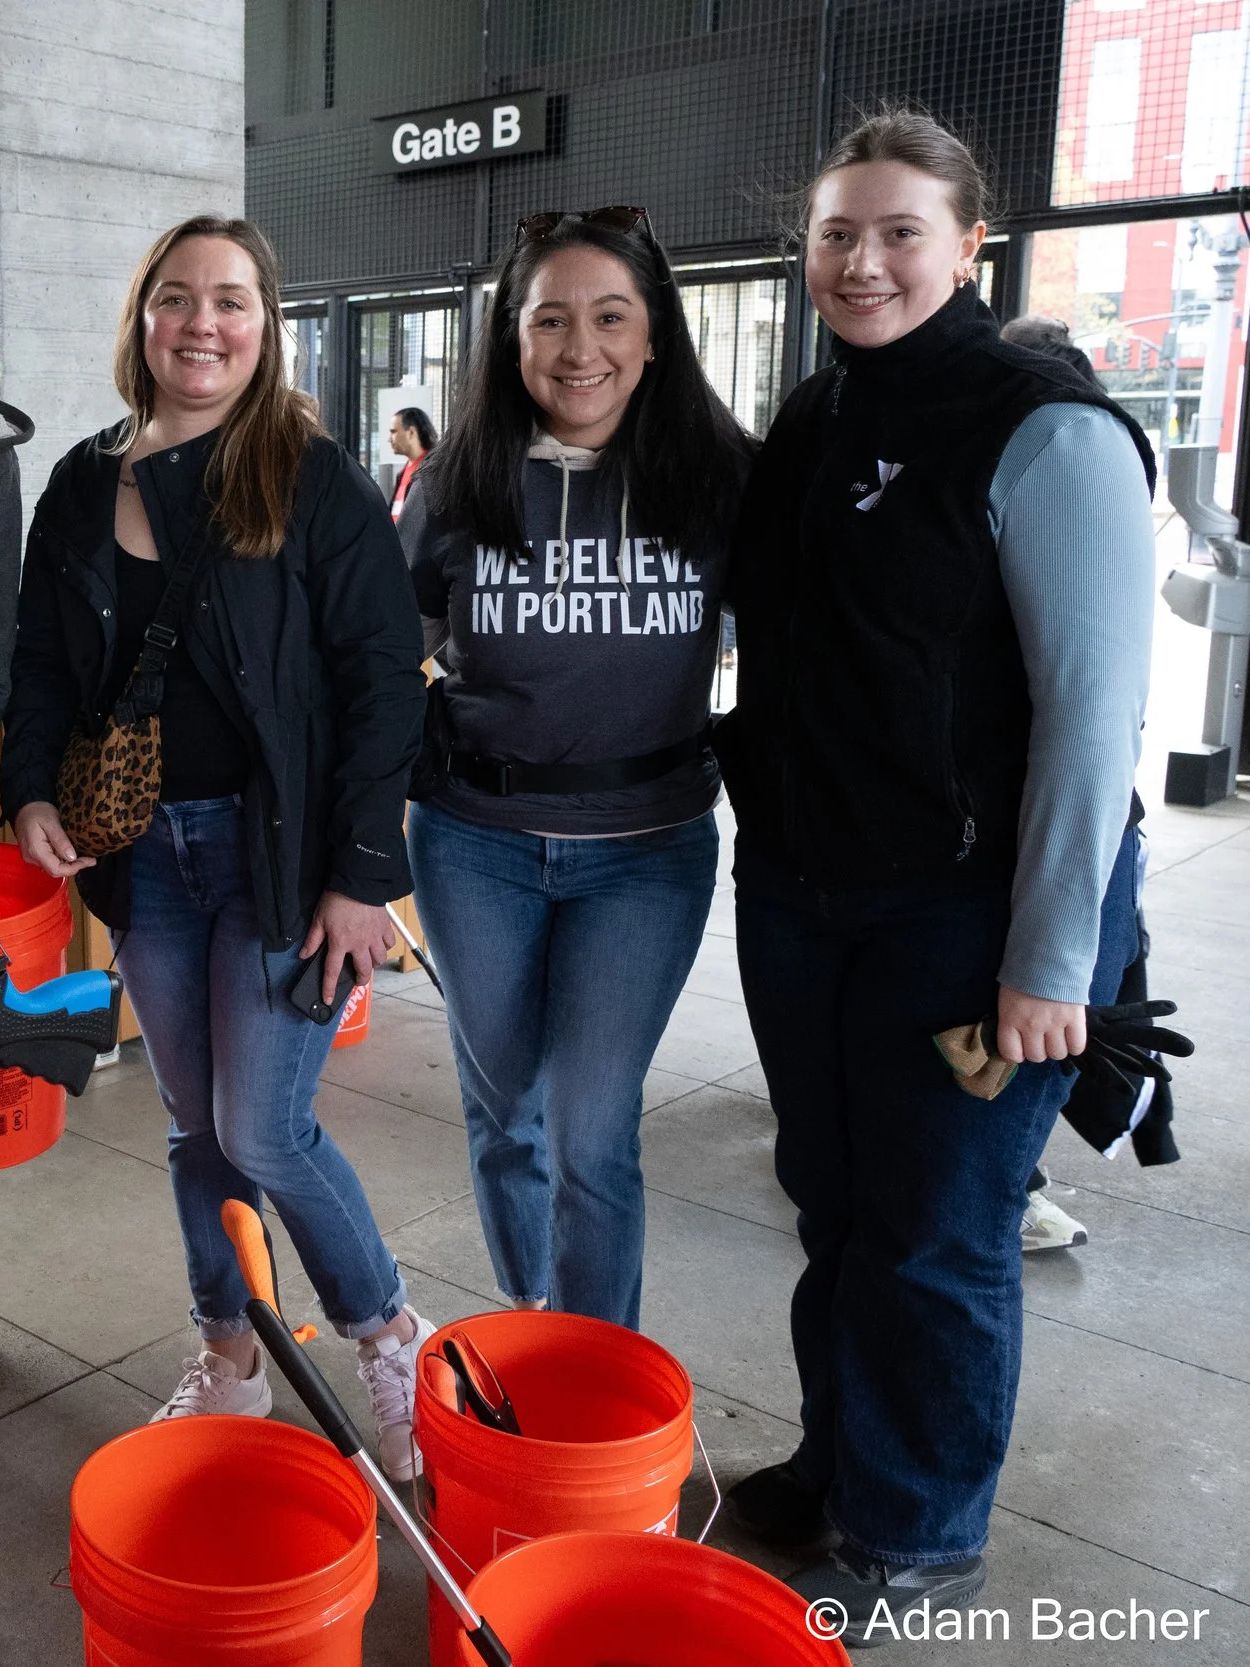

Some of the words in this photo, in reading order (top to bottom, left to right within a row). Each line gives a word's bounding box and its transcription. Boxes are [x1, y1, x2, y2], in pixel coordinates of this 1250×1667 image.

[392, 118, 481, 164] Gate
[493, 105, 521, 148] B
[472, 592, 504, 634] IN
[516, 590, 704, 635] PORTLAND
